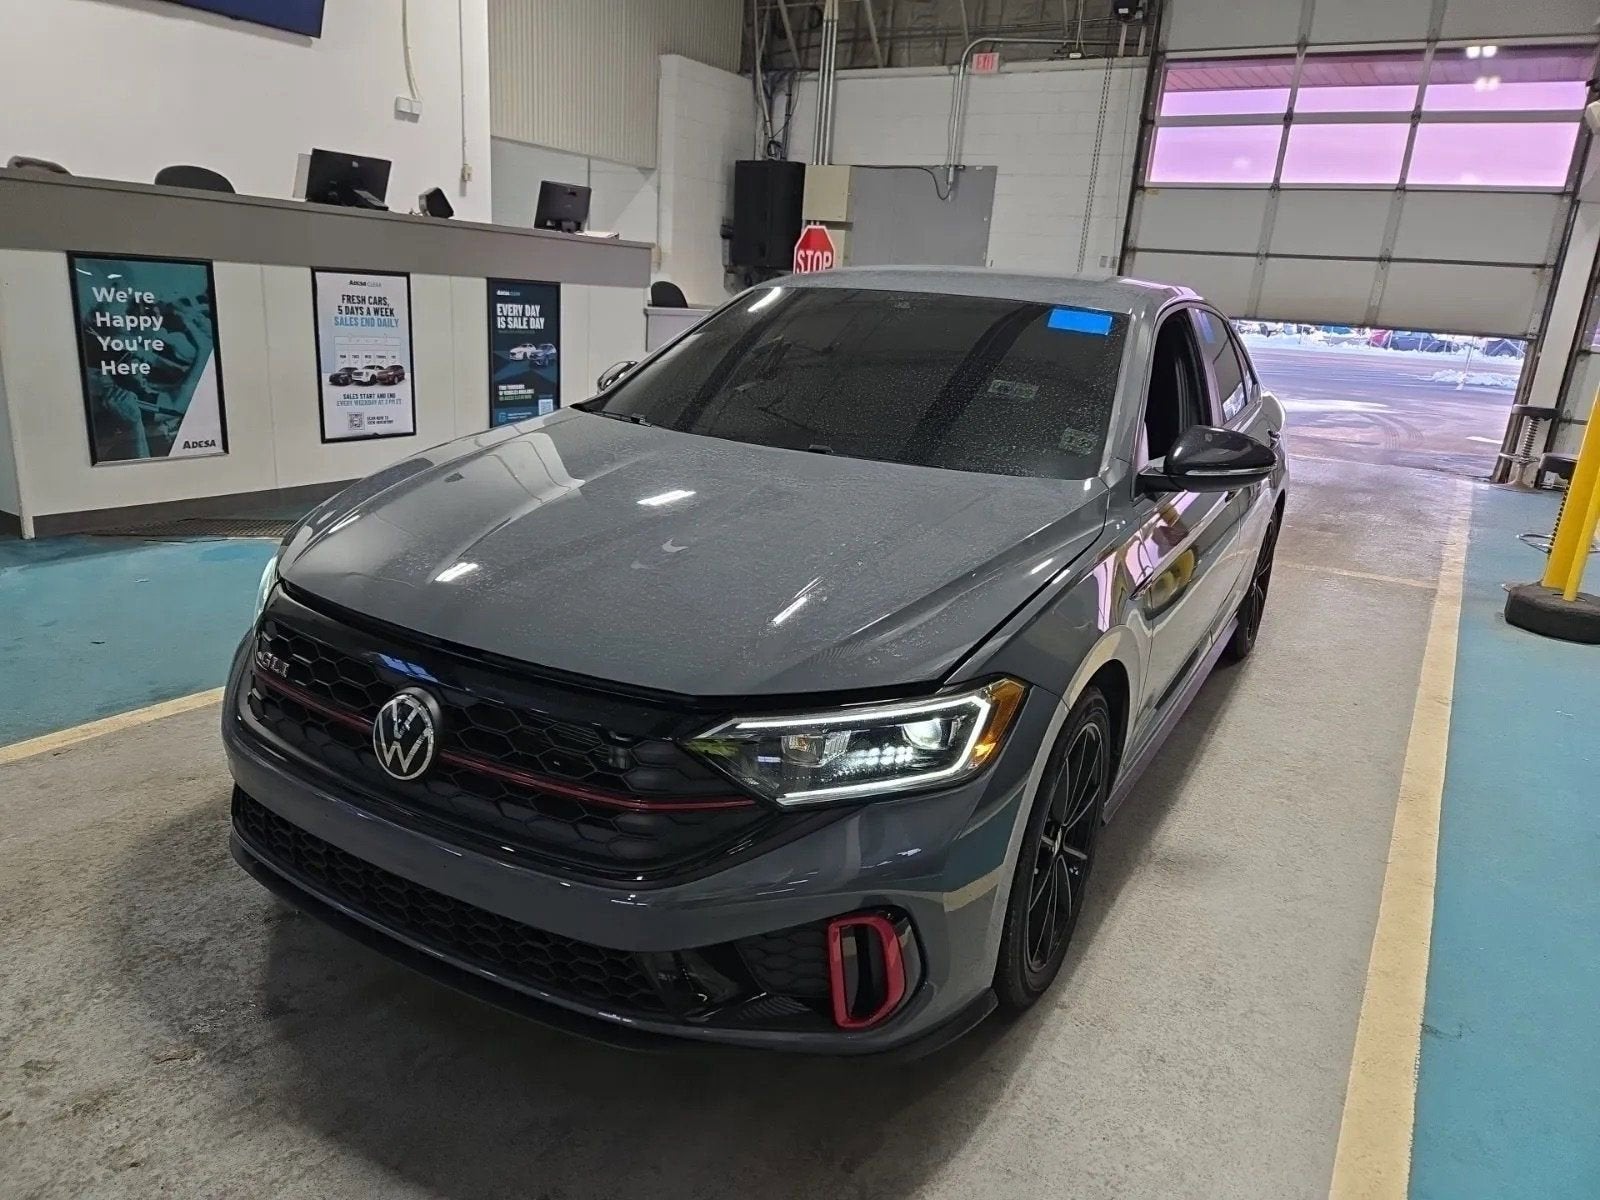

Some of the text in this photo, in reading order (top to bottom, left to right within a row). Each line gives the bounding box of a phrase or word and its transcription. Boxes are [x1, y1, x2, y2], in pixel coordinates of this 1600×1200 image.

[797, 250, 832, 274] STOP
[91, 286, 155, 304] We're
[341, 294, 390, 308] FRESH CARS,
[337, 305, 395, 317] 5 DAYS A WEEK
[496, 303, 541, 317] EVERY DAY
[95, 311, 164, 331] Happy
[334, 316, 399, 328] SALES END DAILY
[497, 316, 545, 330] IS SALE DAY
[97, 335, 165, 352] You're
[101, 360, 151, 376] Here
[182, 439, 217, 450] ADESA
[262, 651, 290, 678] GLI
[374, 696, 435, 780] VW
